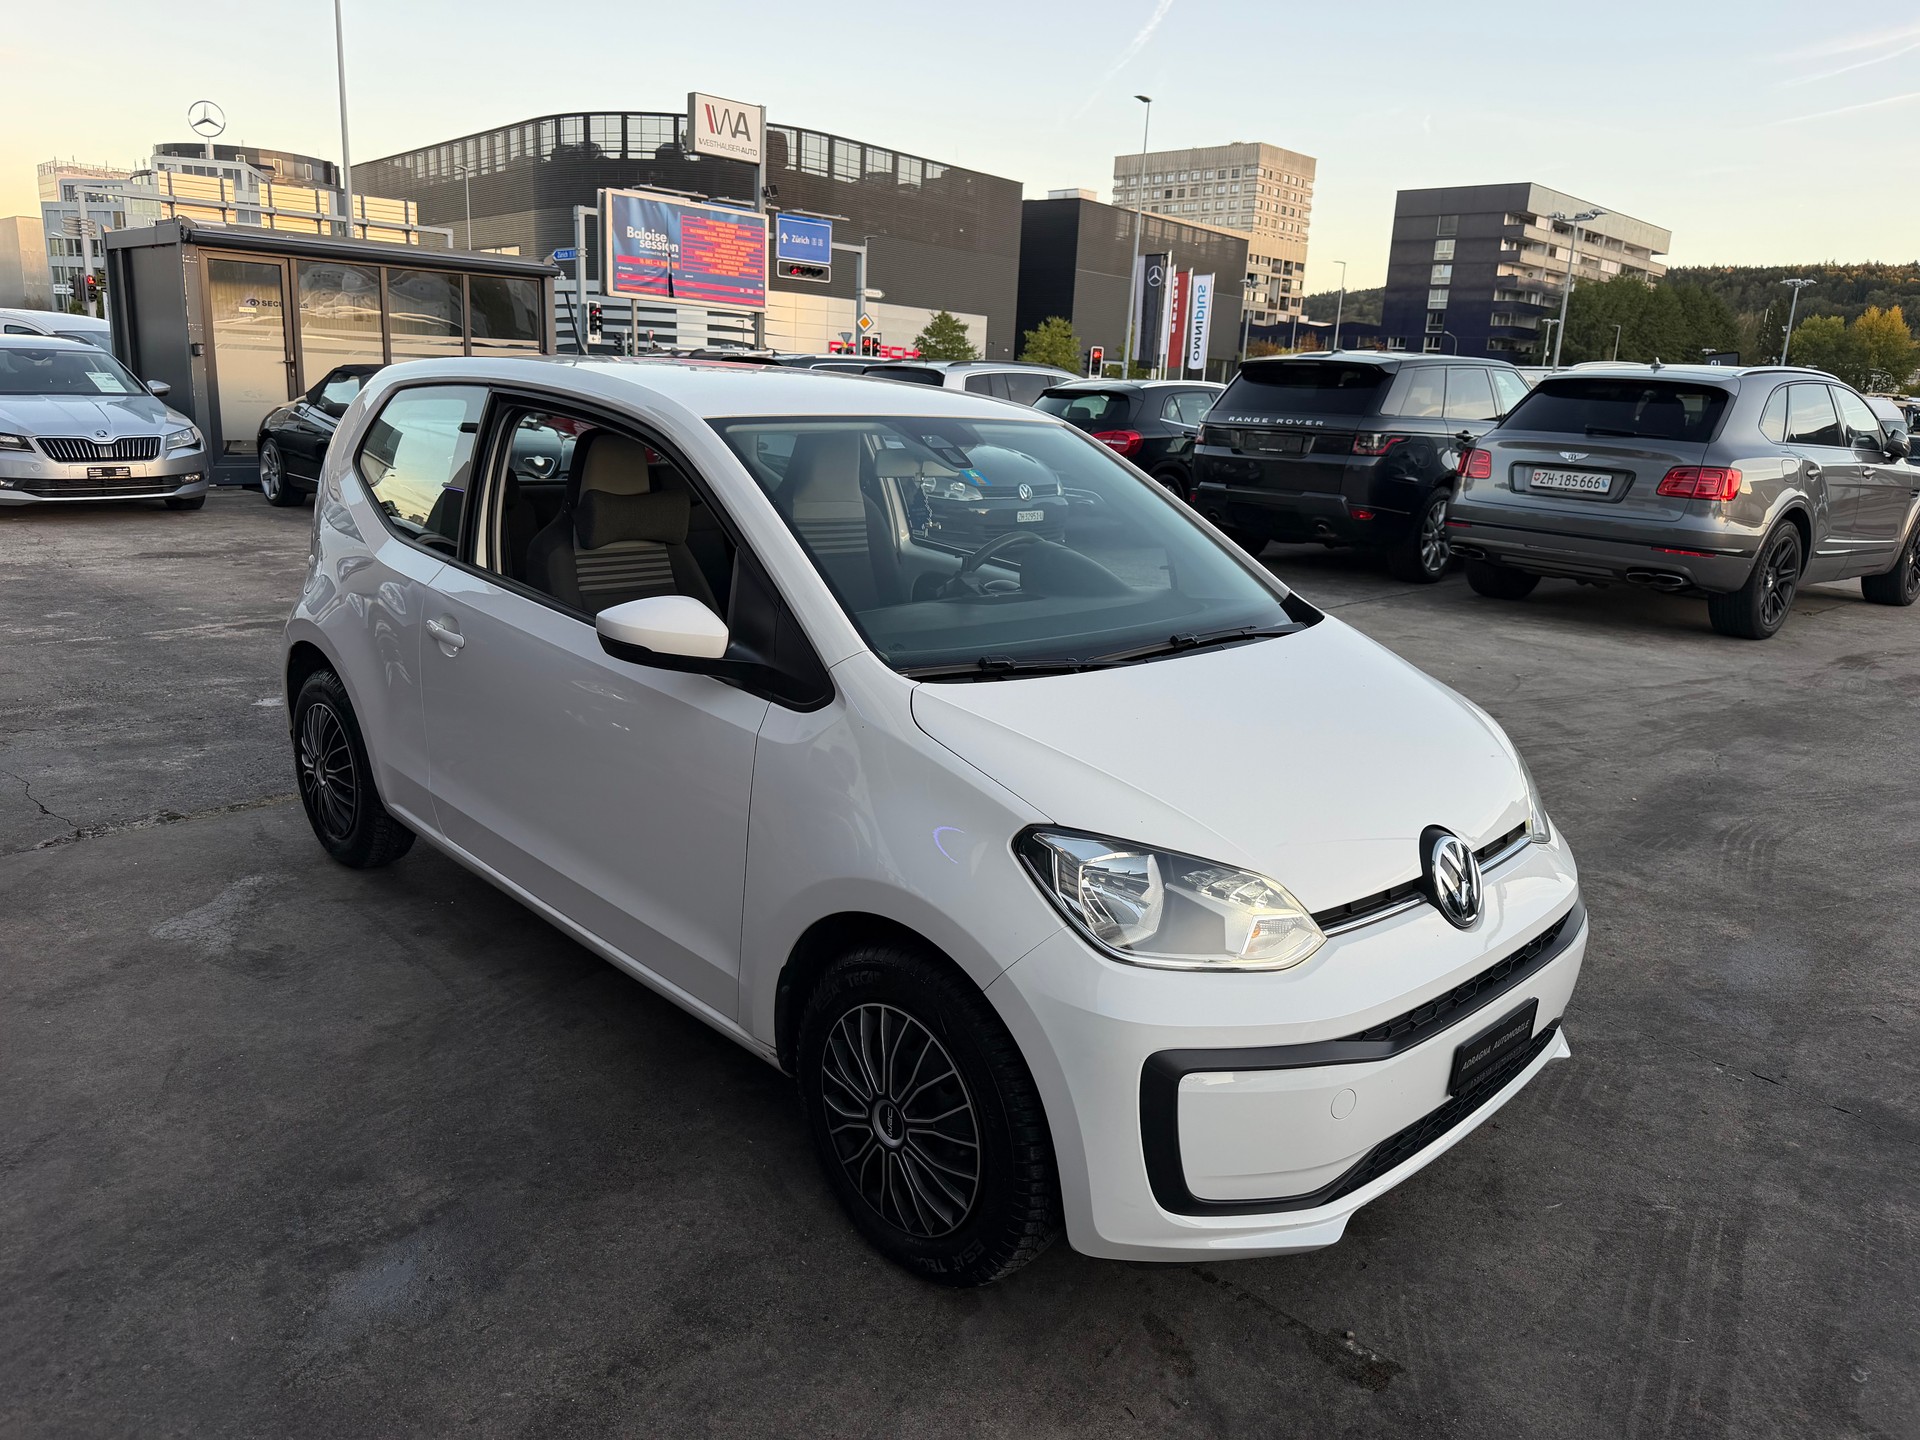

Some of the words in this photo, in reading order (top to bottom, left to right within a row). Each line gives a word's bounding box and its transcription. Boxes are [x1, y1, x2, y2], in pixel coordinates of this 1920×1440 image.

[626, 226, 667, 242] Baloise
[791, 234, 810, 245] Zürich
[829, 341, 922, 359] PSCH
[1228, 415, 1269, 423] RANGE
[1276, 418, 1324, 426] ROVER
